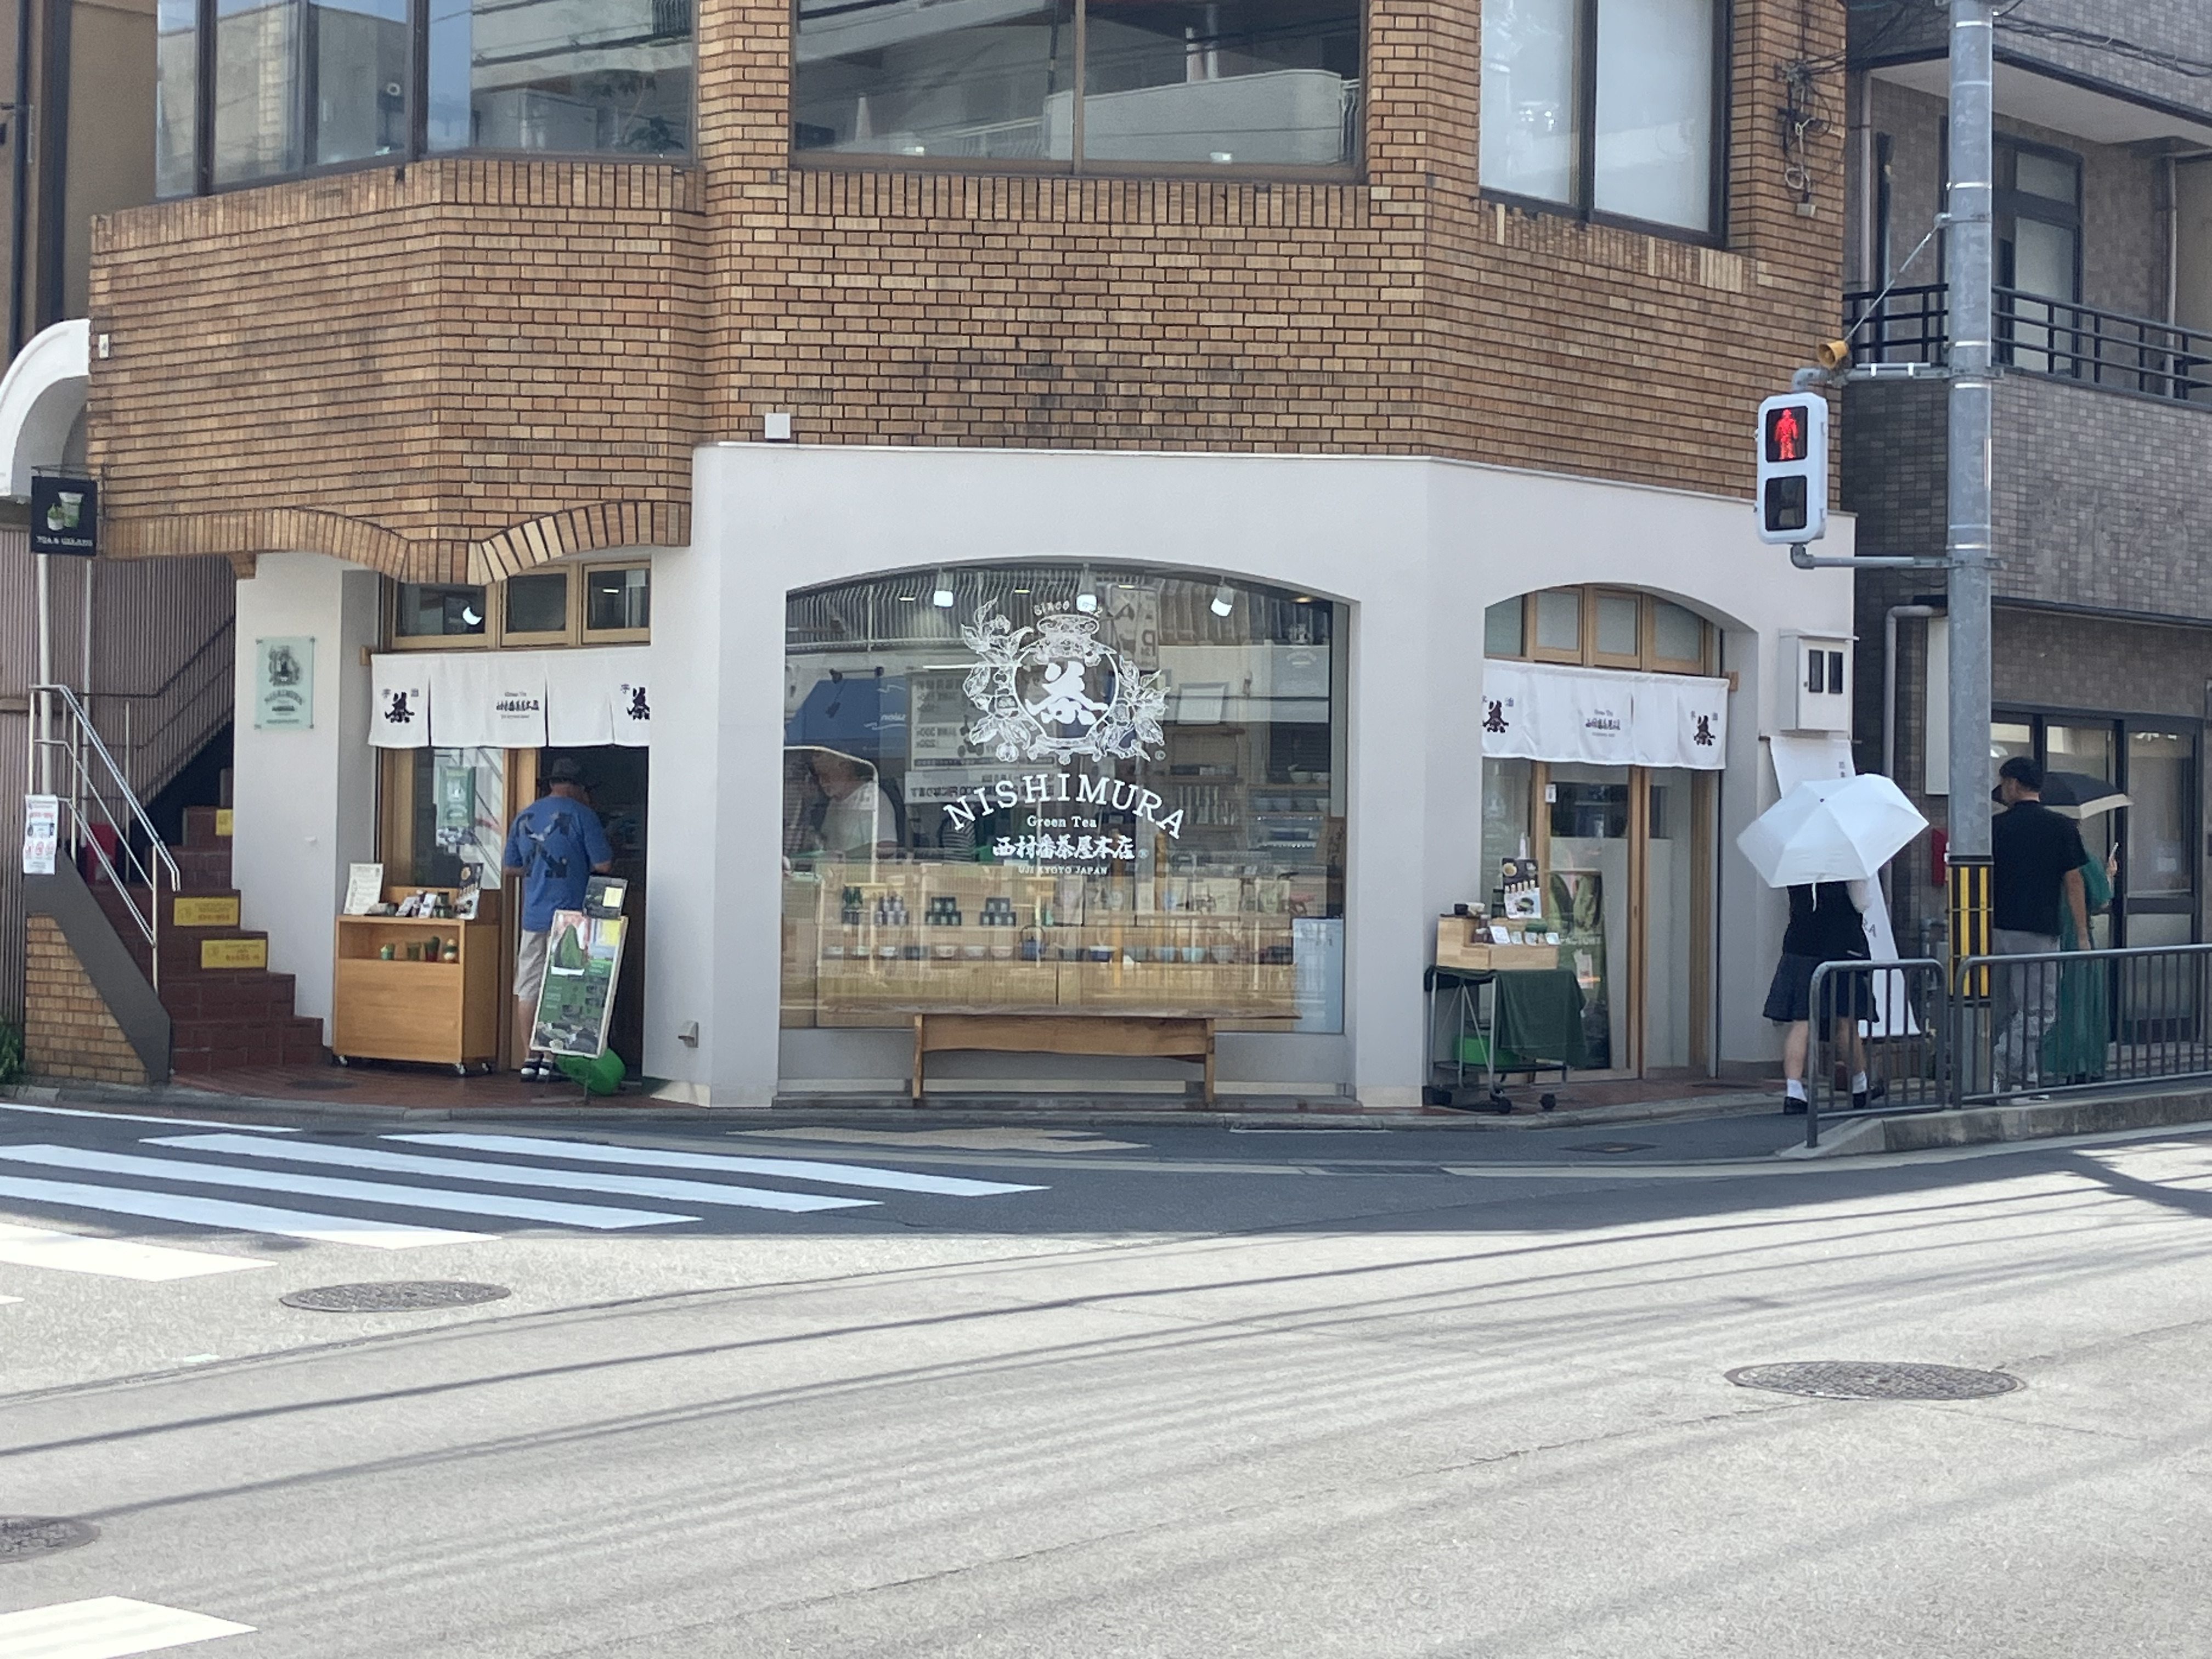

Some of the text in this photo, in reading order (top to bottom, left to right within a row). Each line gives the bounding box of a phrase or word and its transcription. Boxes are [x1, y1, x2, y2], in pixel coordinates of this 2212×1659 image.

[943, 773, 1186, 839] NISHIMURA
[1027, 816, 1097, 828] Green Tea
[992, 835, 1135, 860] 西村番茶屋本店
[1075, 867, 1108, 875] JAPAN
